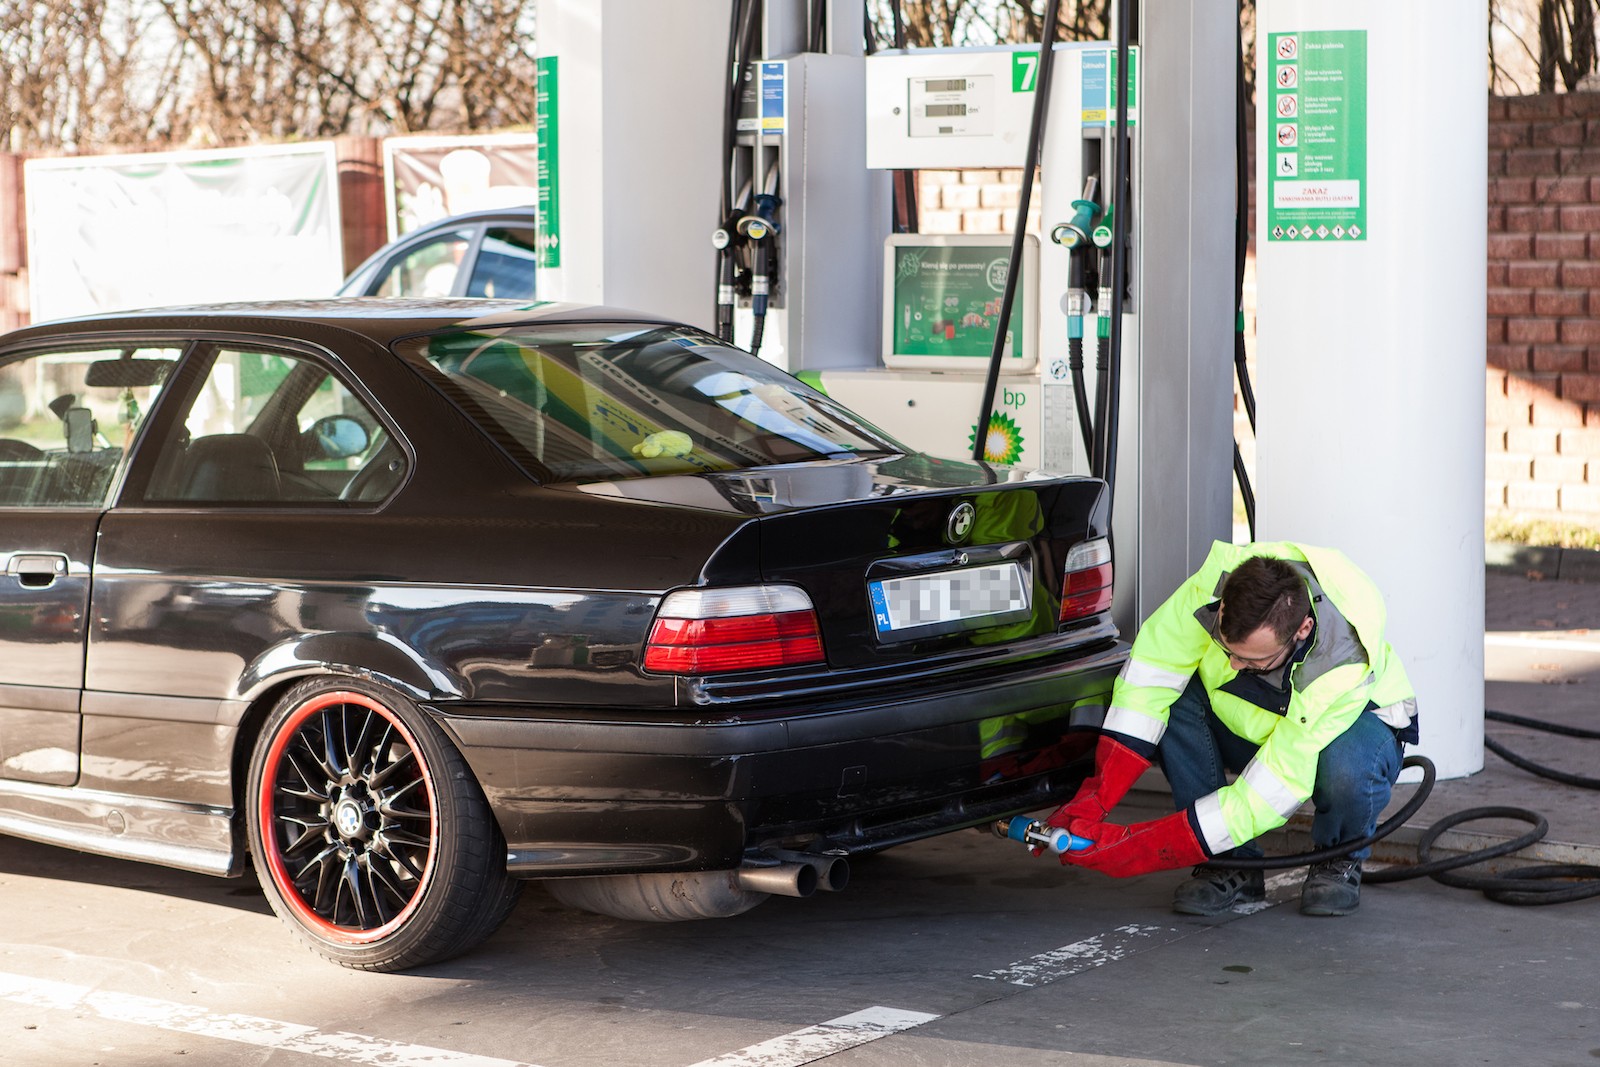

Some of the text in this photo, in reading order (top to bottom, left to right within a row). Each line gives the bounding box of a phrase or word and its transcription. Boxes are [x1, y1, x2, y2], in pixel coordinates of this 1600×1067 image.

[1322, 42, 1344, 51] palenia
[1017, 56, 1036, 90] 7
[921, 262, 939, 271] Kieruj
[1004, 387, 1026, 410] bp
[877, 613, 889, 626] PL
